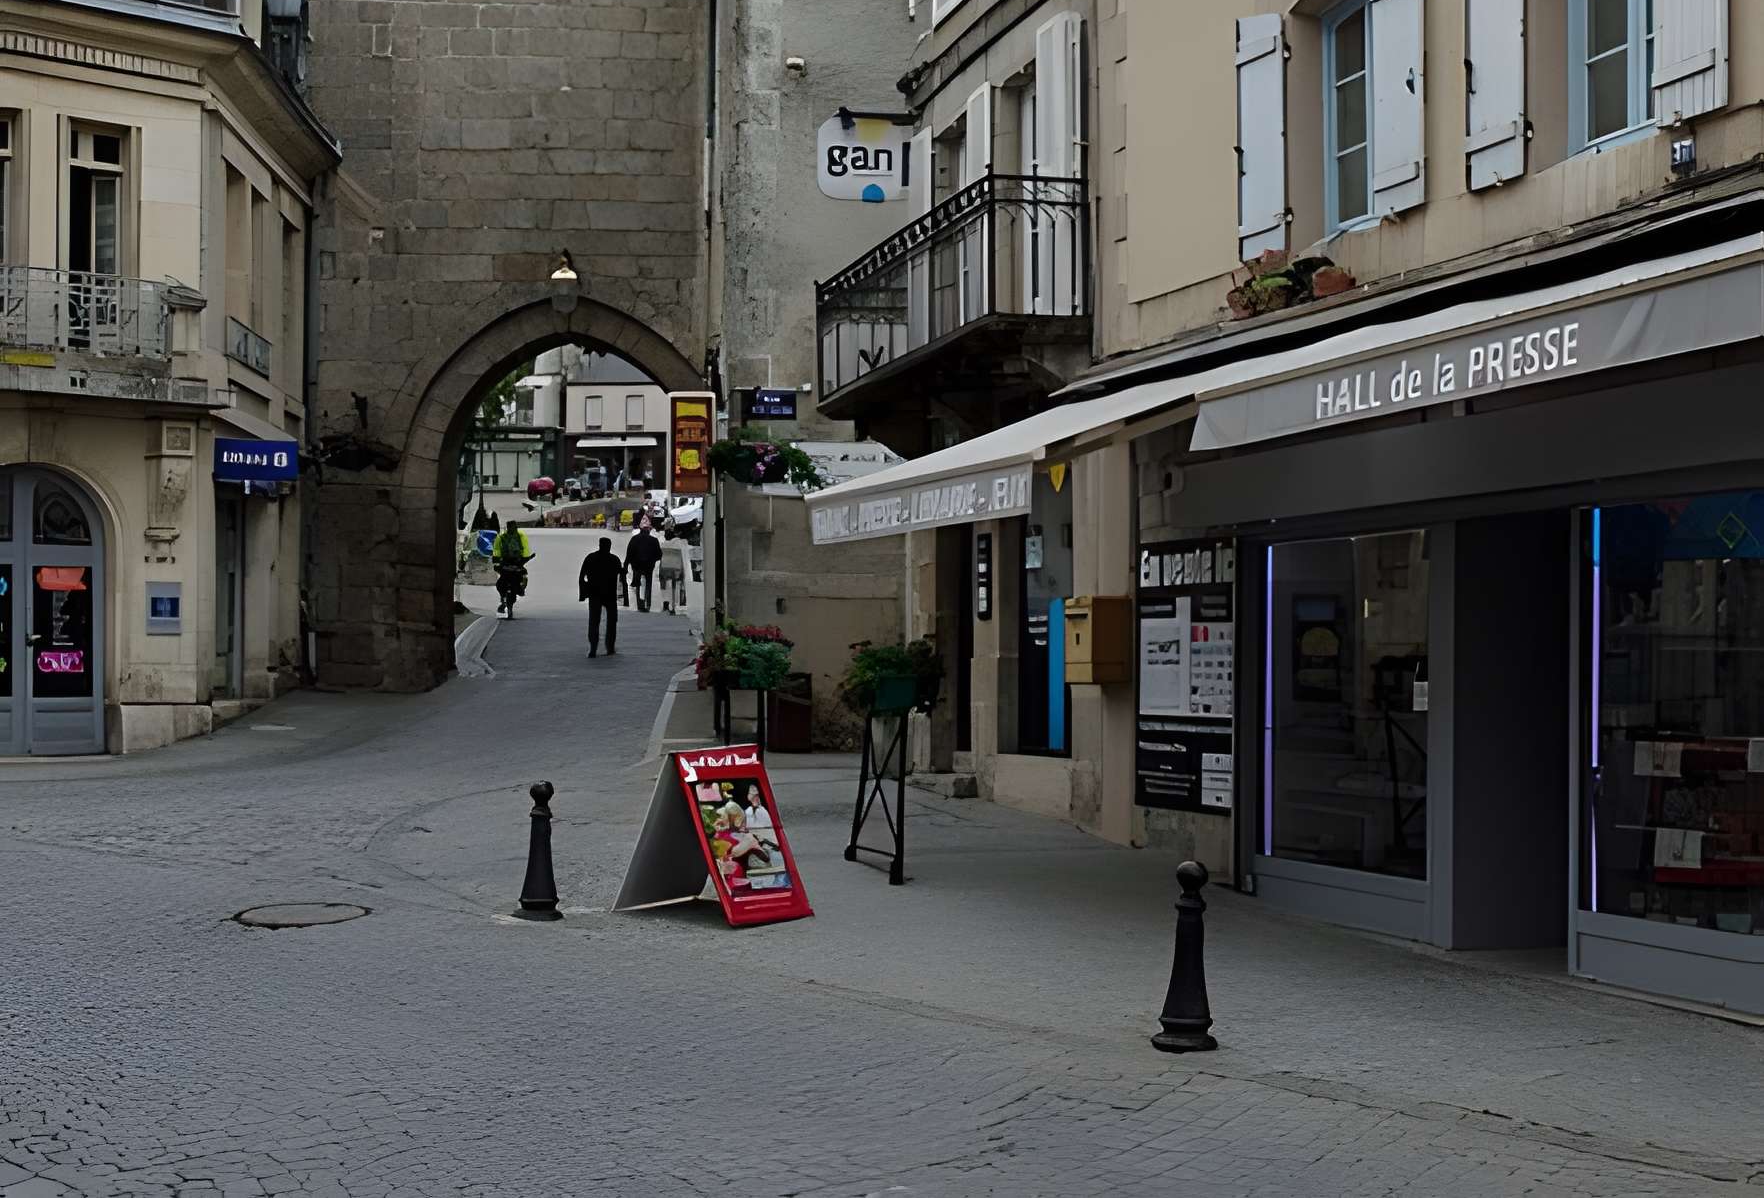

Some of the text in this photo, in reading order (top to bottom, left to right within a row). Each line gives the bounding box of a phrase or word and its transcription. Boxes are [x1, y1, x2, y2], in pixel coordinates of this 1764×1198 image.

[828, 145, 893, 177] gan
[1316, 322, 1580, 419] HALL de la PRESSE
